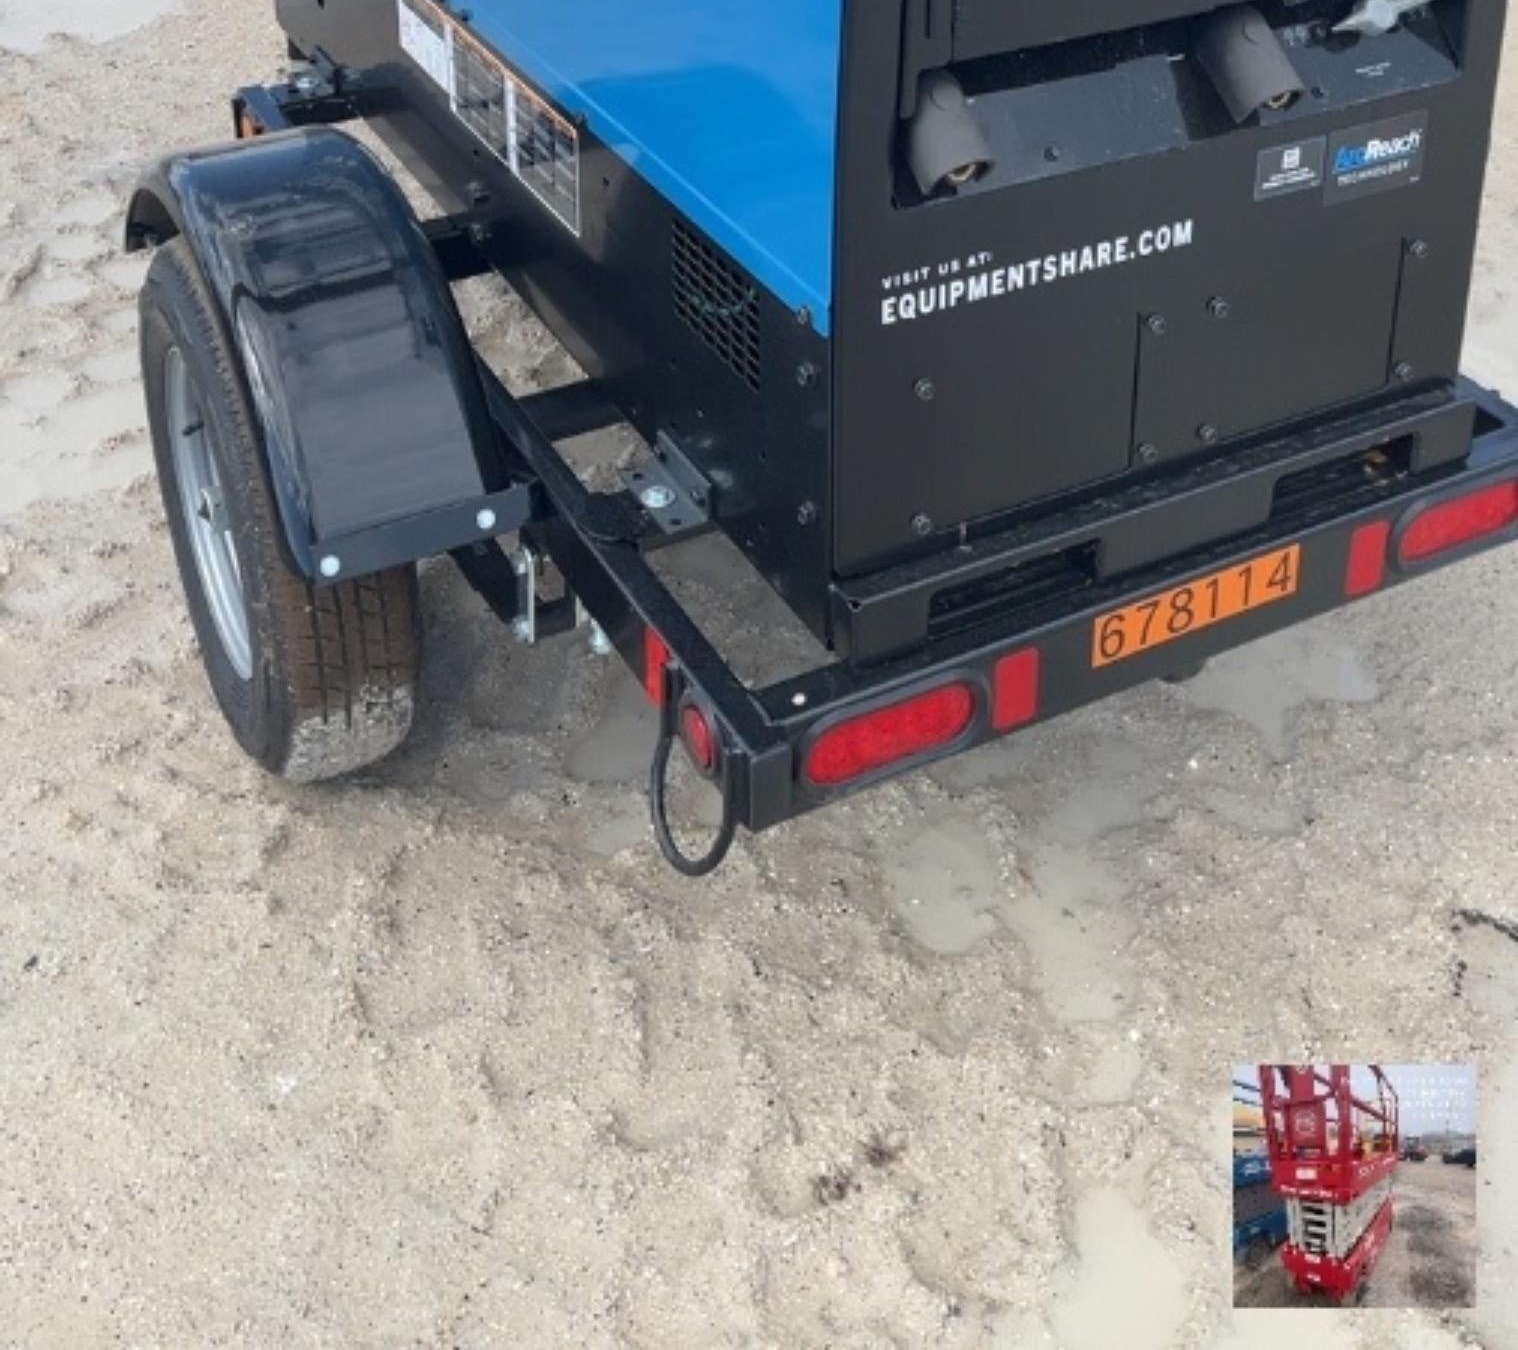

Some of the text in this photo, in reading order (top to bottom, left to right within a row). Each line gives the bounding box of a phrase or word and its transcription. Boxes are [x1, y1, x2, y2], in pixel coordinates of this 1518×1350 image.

[881, 218, 1194, 325] EQUIPMENTSHARE.COM
[881, 266, 931, 290] VISIT
[938, 261, 961, 276] US
[1100, 551, 1291, 658] 678114
